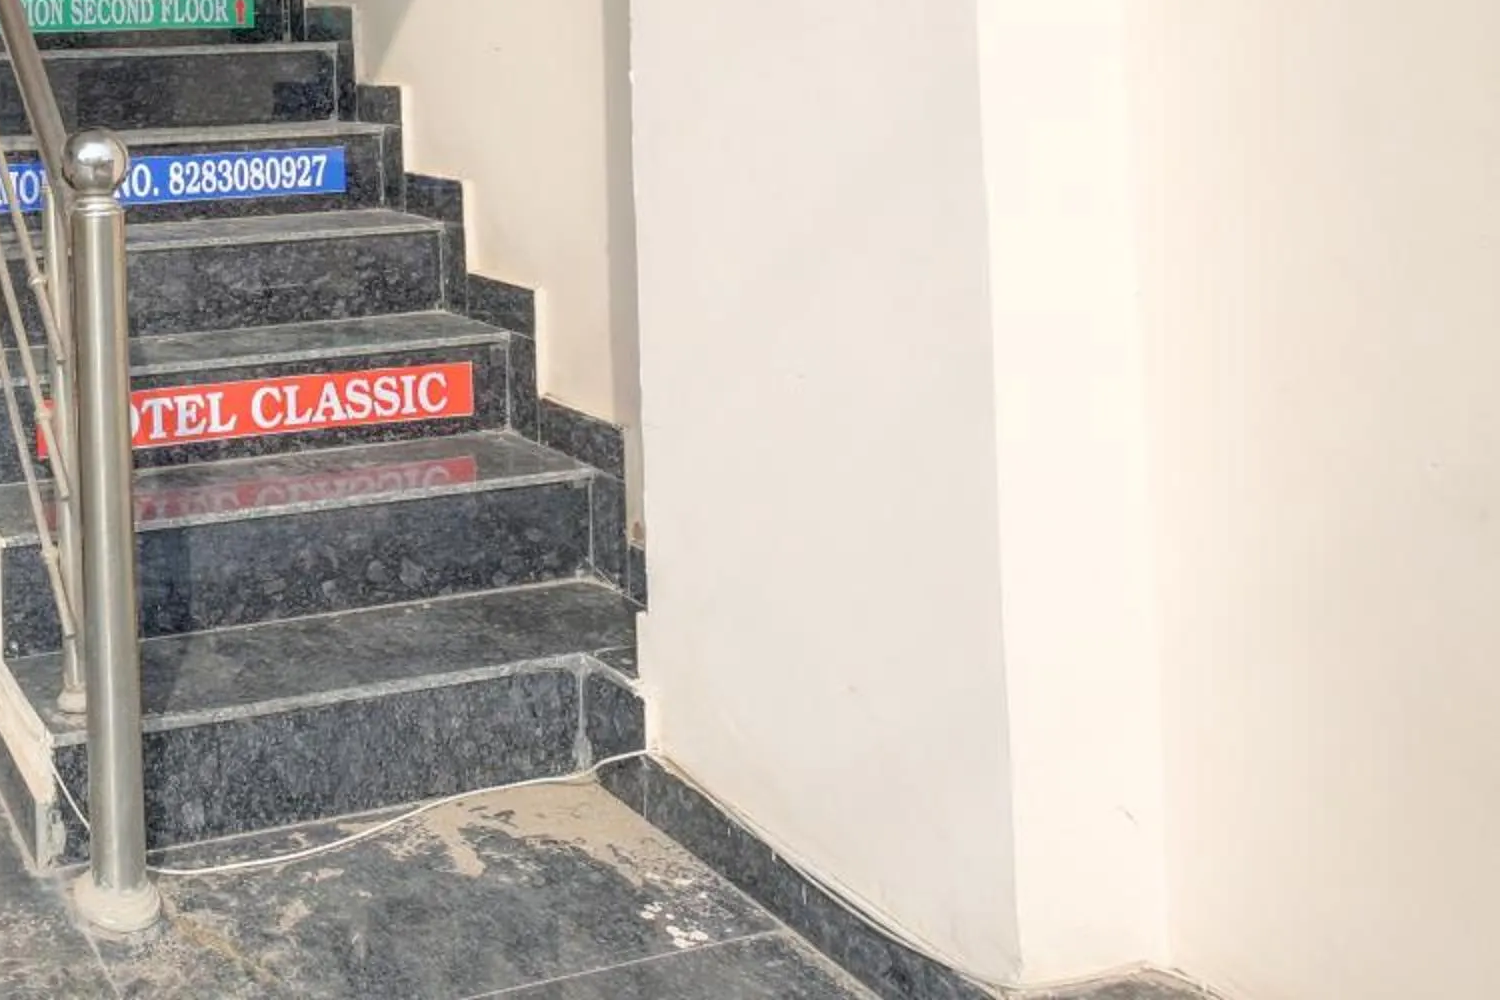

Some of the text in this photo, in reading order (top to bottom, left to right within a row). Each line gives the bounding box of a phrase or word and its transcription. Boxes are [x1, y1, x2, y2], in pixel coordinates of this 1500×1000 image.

[168, 154, 328, 196] 8283080927
[130, 370, 449, 442] TEL CLASSIC
